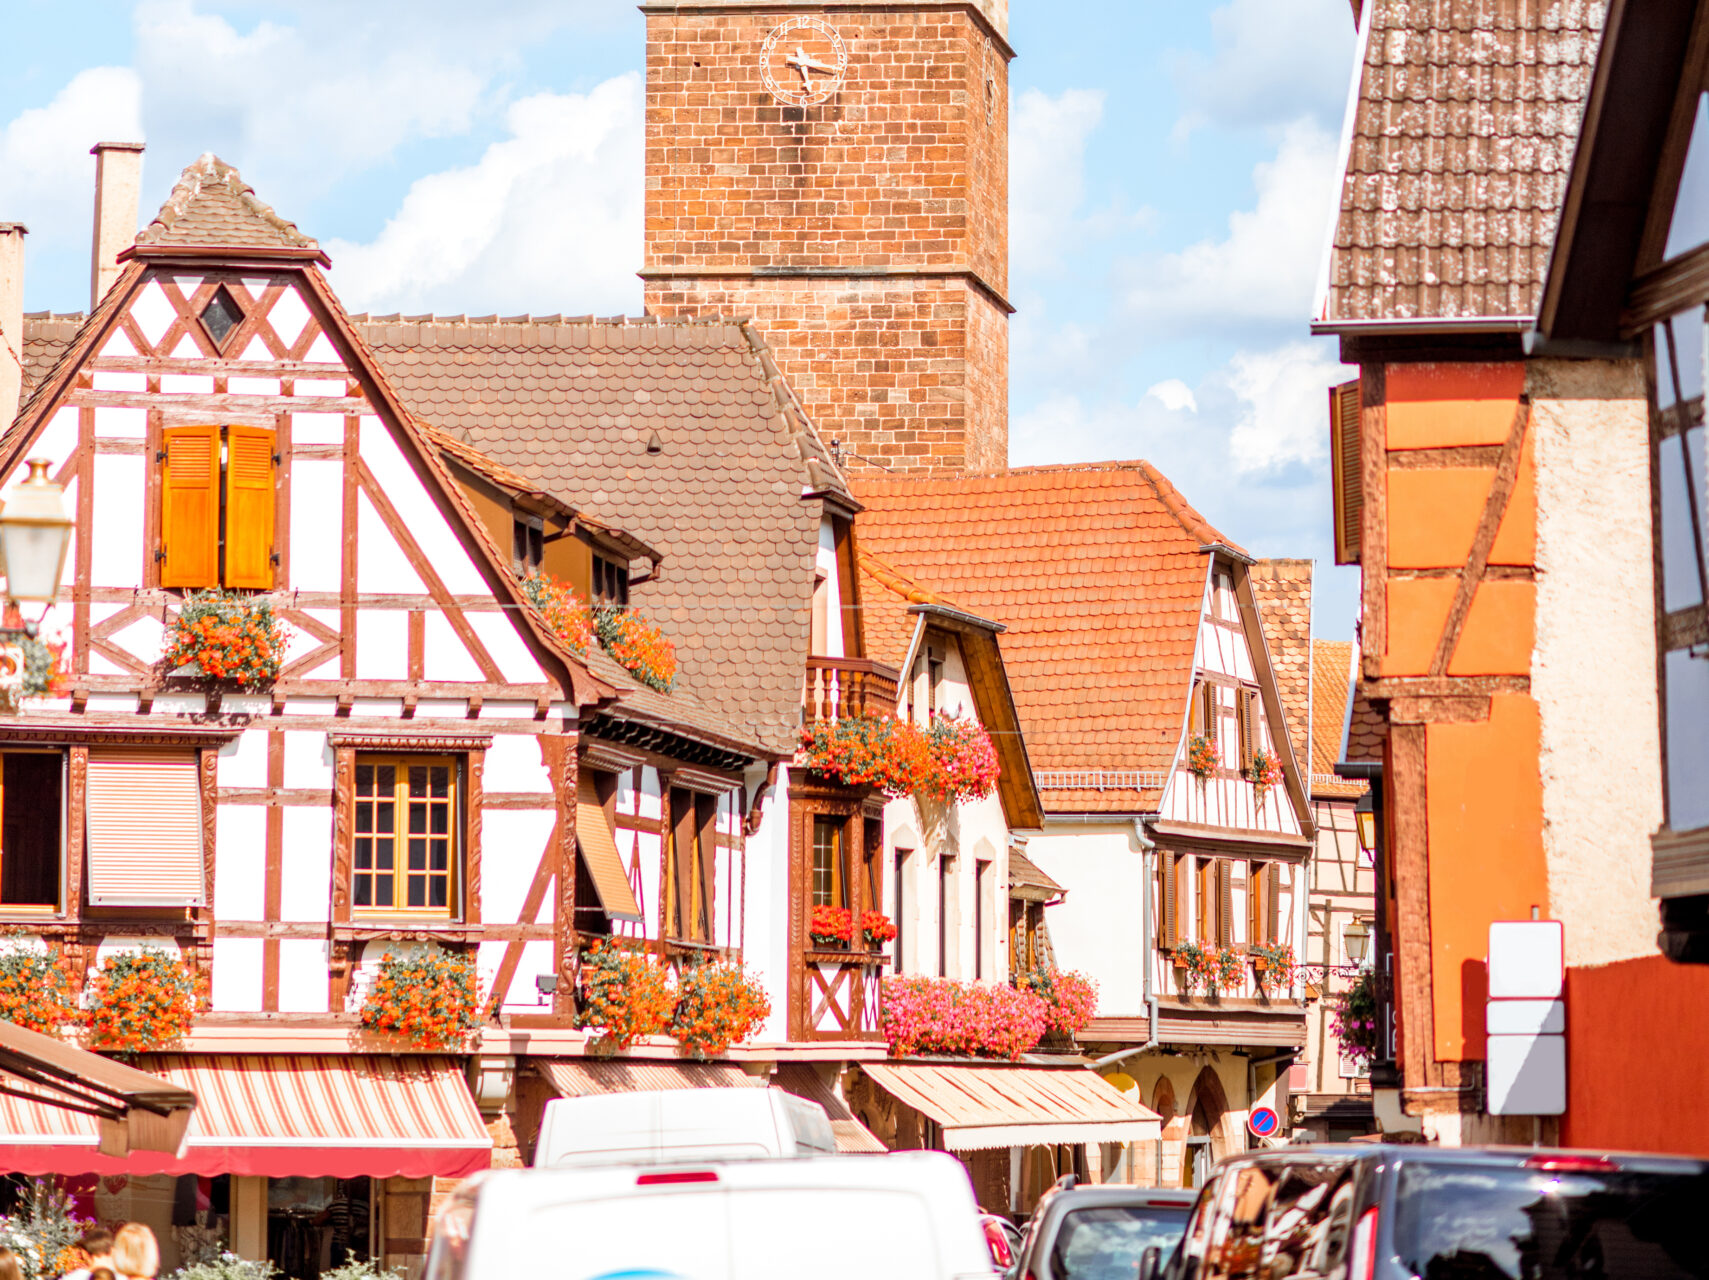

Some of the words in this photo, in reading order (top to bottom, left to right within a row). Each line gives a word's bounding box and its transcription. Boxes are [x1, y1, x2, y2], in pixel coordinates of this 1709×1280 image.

[797, 16, 809, 29] 12
[762, 36, 776, 50] 10
[834, 33, 841, 48] 2
[760, 56, 768, 69] 9
[800, 94, 807, 108] 6
